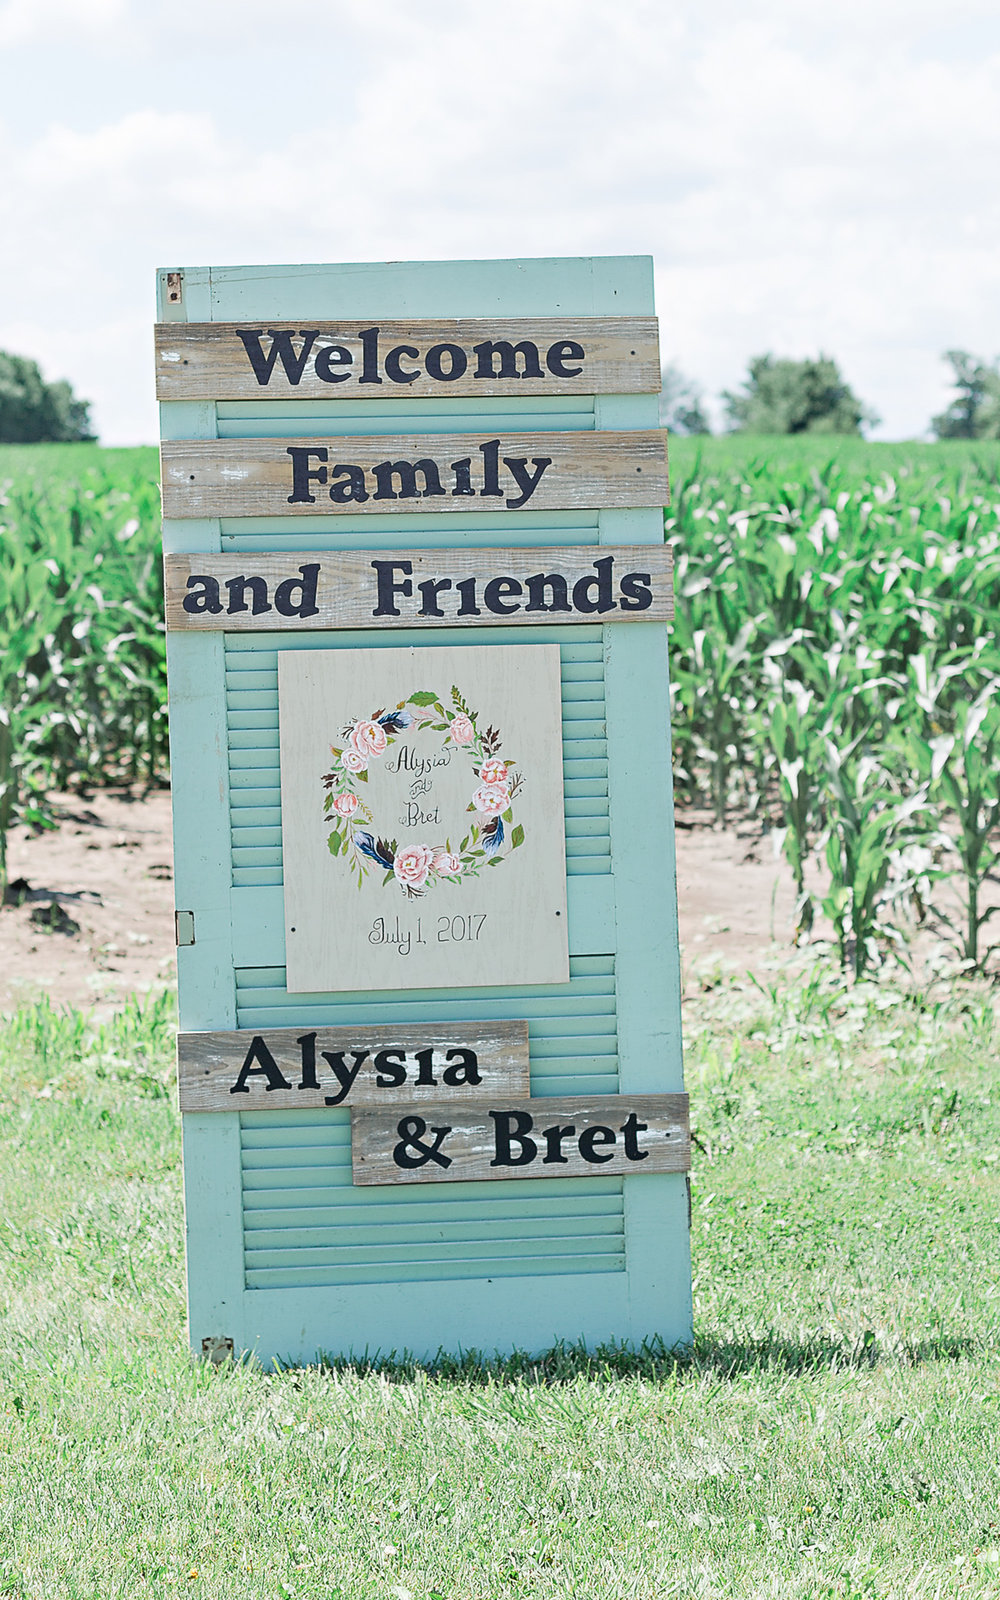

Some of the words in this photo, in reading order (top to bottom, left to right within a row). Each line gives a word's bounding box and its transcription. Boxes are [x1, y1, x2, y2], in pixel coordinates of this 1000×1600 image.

[235, 326, 586, 386] Welcome
[286, 438, 553, 509] Family
[182, 563, 321, 619] and
[370, 555, 653, 618] Friends
[385, 745, 458, 778] Alysia
[399, 801, 442, 828] Bret
[368, 915, 411, 956] July
[437, 914, 487, 942] 2017
[230, 1031, 482, 1106] Alysia
[392, 1115, 453, 1170] &
[489, 1110, 650, 1167] Bret
